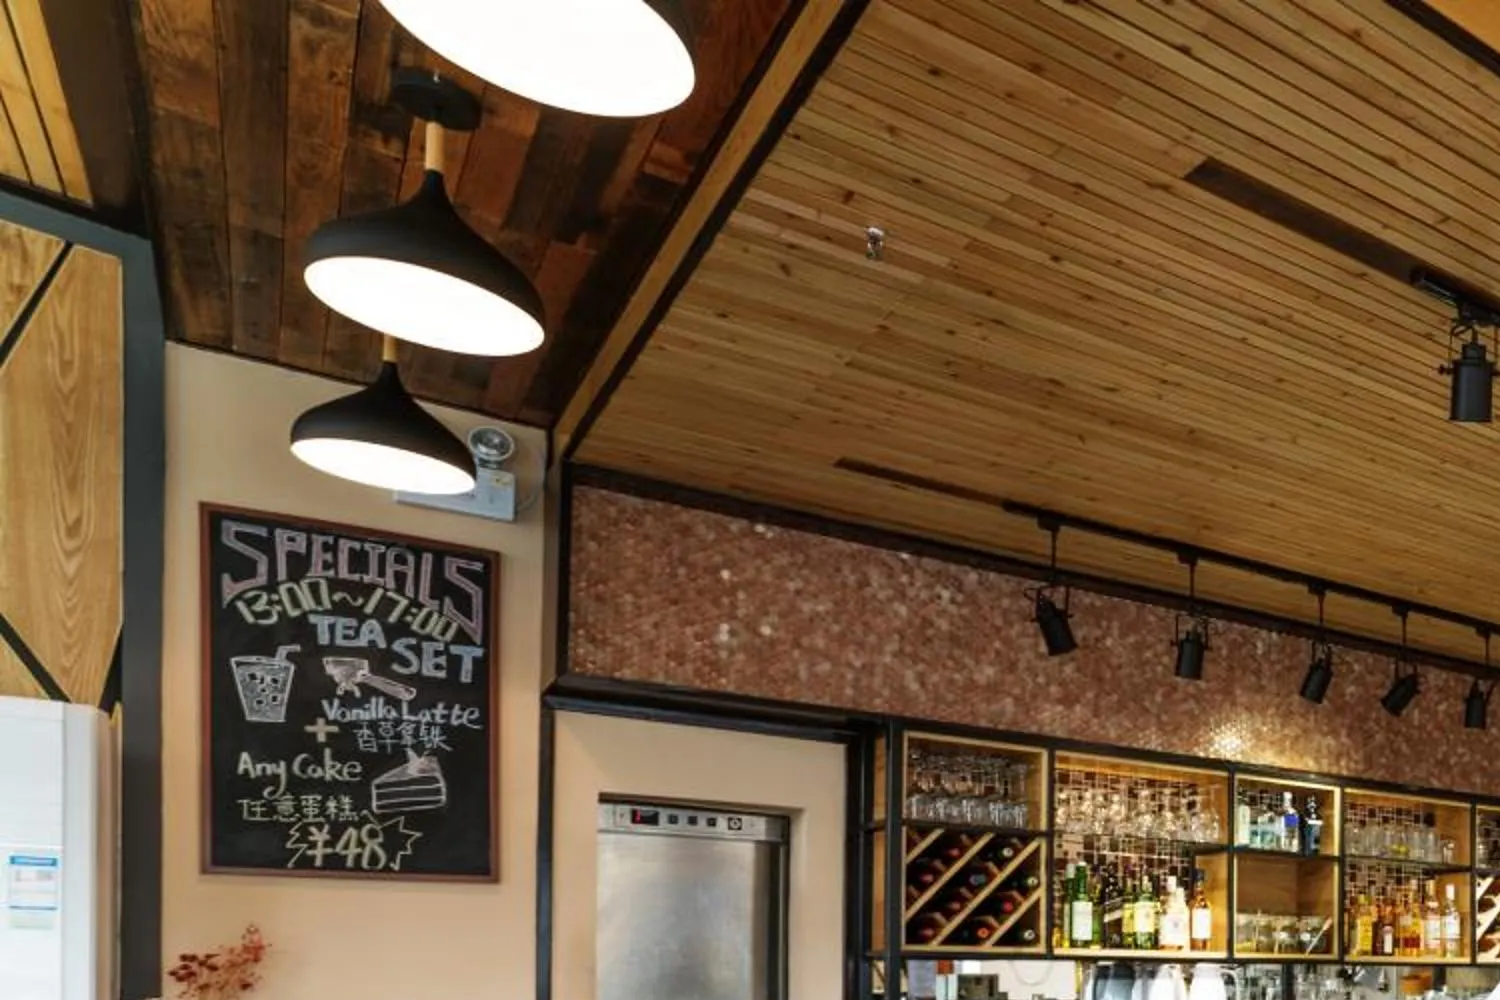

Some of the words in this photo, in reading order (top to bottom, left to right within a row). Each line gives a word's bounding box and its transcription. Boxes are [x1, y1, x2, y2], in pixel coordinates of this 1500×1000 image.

[221, 521, 484, 645] SPECIALS
[309, 613, 387, 648] TEA
[391, 637, 484, 683] SET
[401, 701, 483, 729] Latte
[237, 751, 286, 800] Any
[292, 747, 363, 781] Cake
[236, 793, 359, 823] 任意蛋糕
